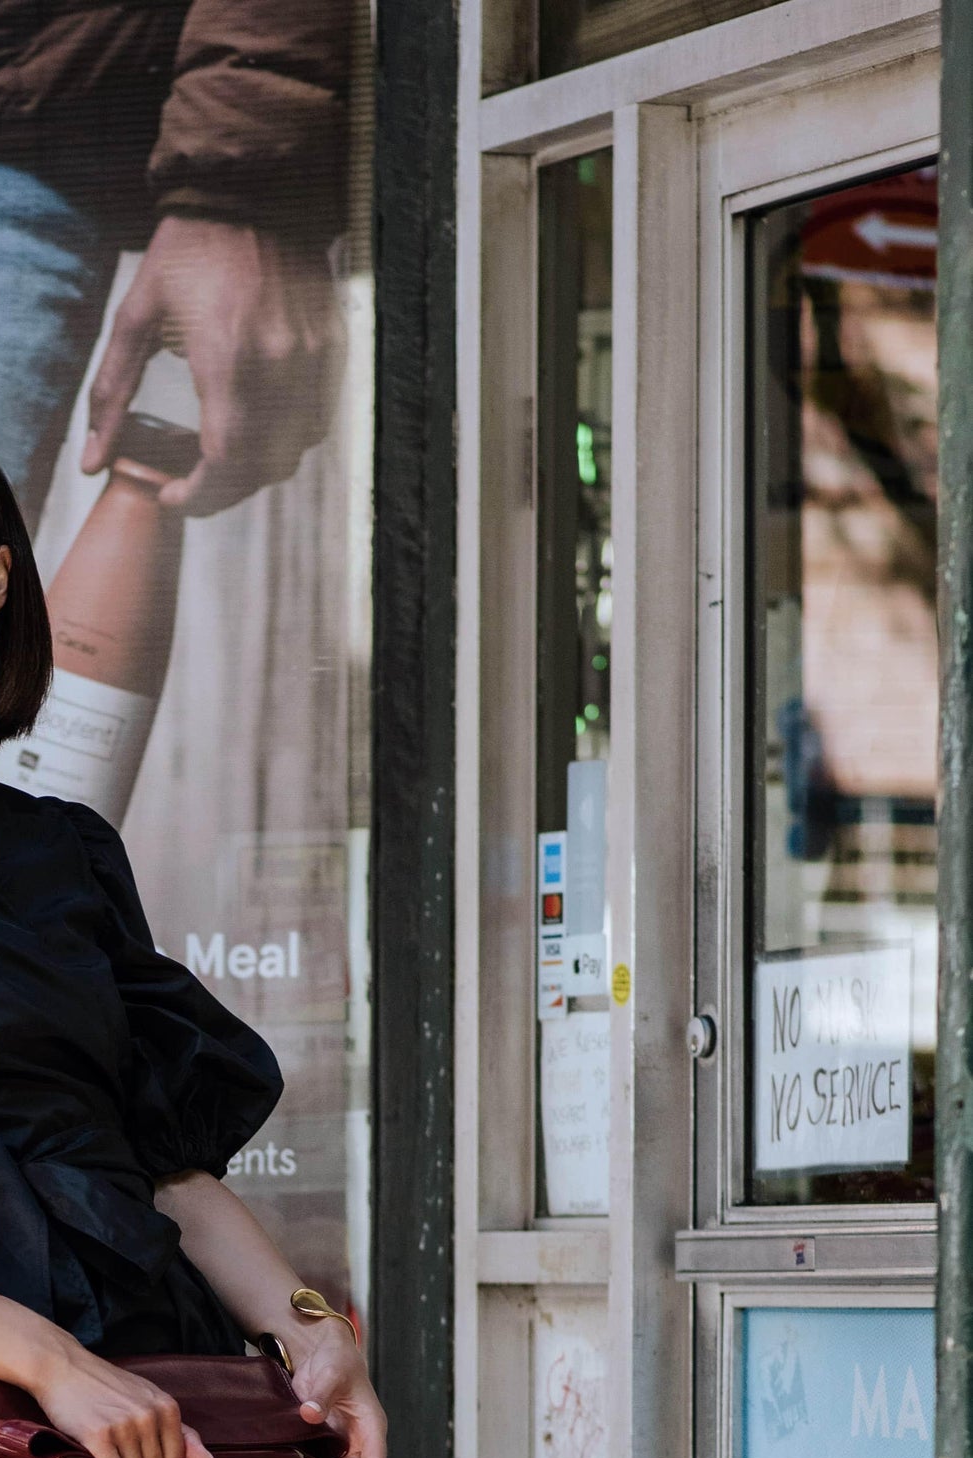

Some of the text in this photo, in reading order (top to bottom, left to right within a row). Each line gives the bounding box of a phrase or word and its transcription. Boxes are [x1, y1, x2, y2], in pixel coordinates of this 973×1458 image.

[185, 930, 300, 979] Meal
[582, 953, 603, 978] Pay
[772, 985, 802, 1054] NO
[771, 1059, 901, 1143] NO SERVICE
[850, 1362, 929, 1441] MA
